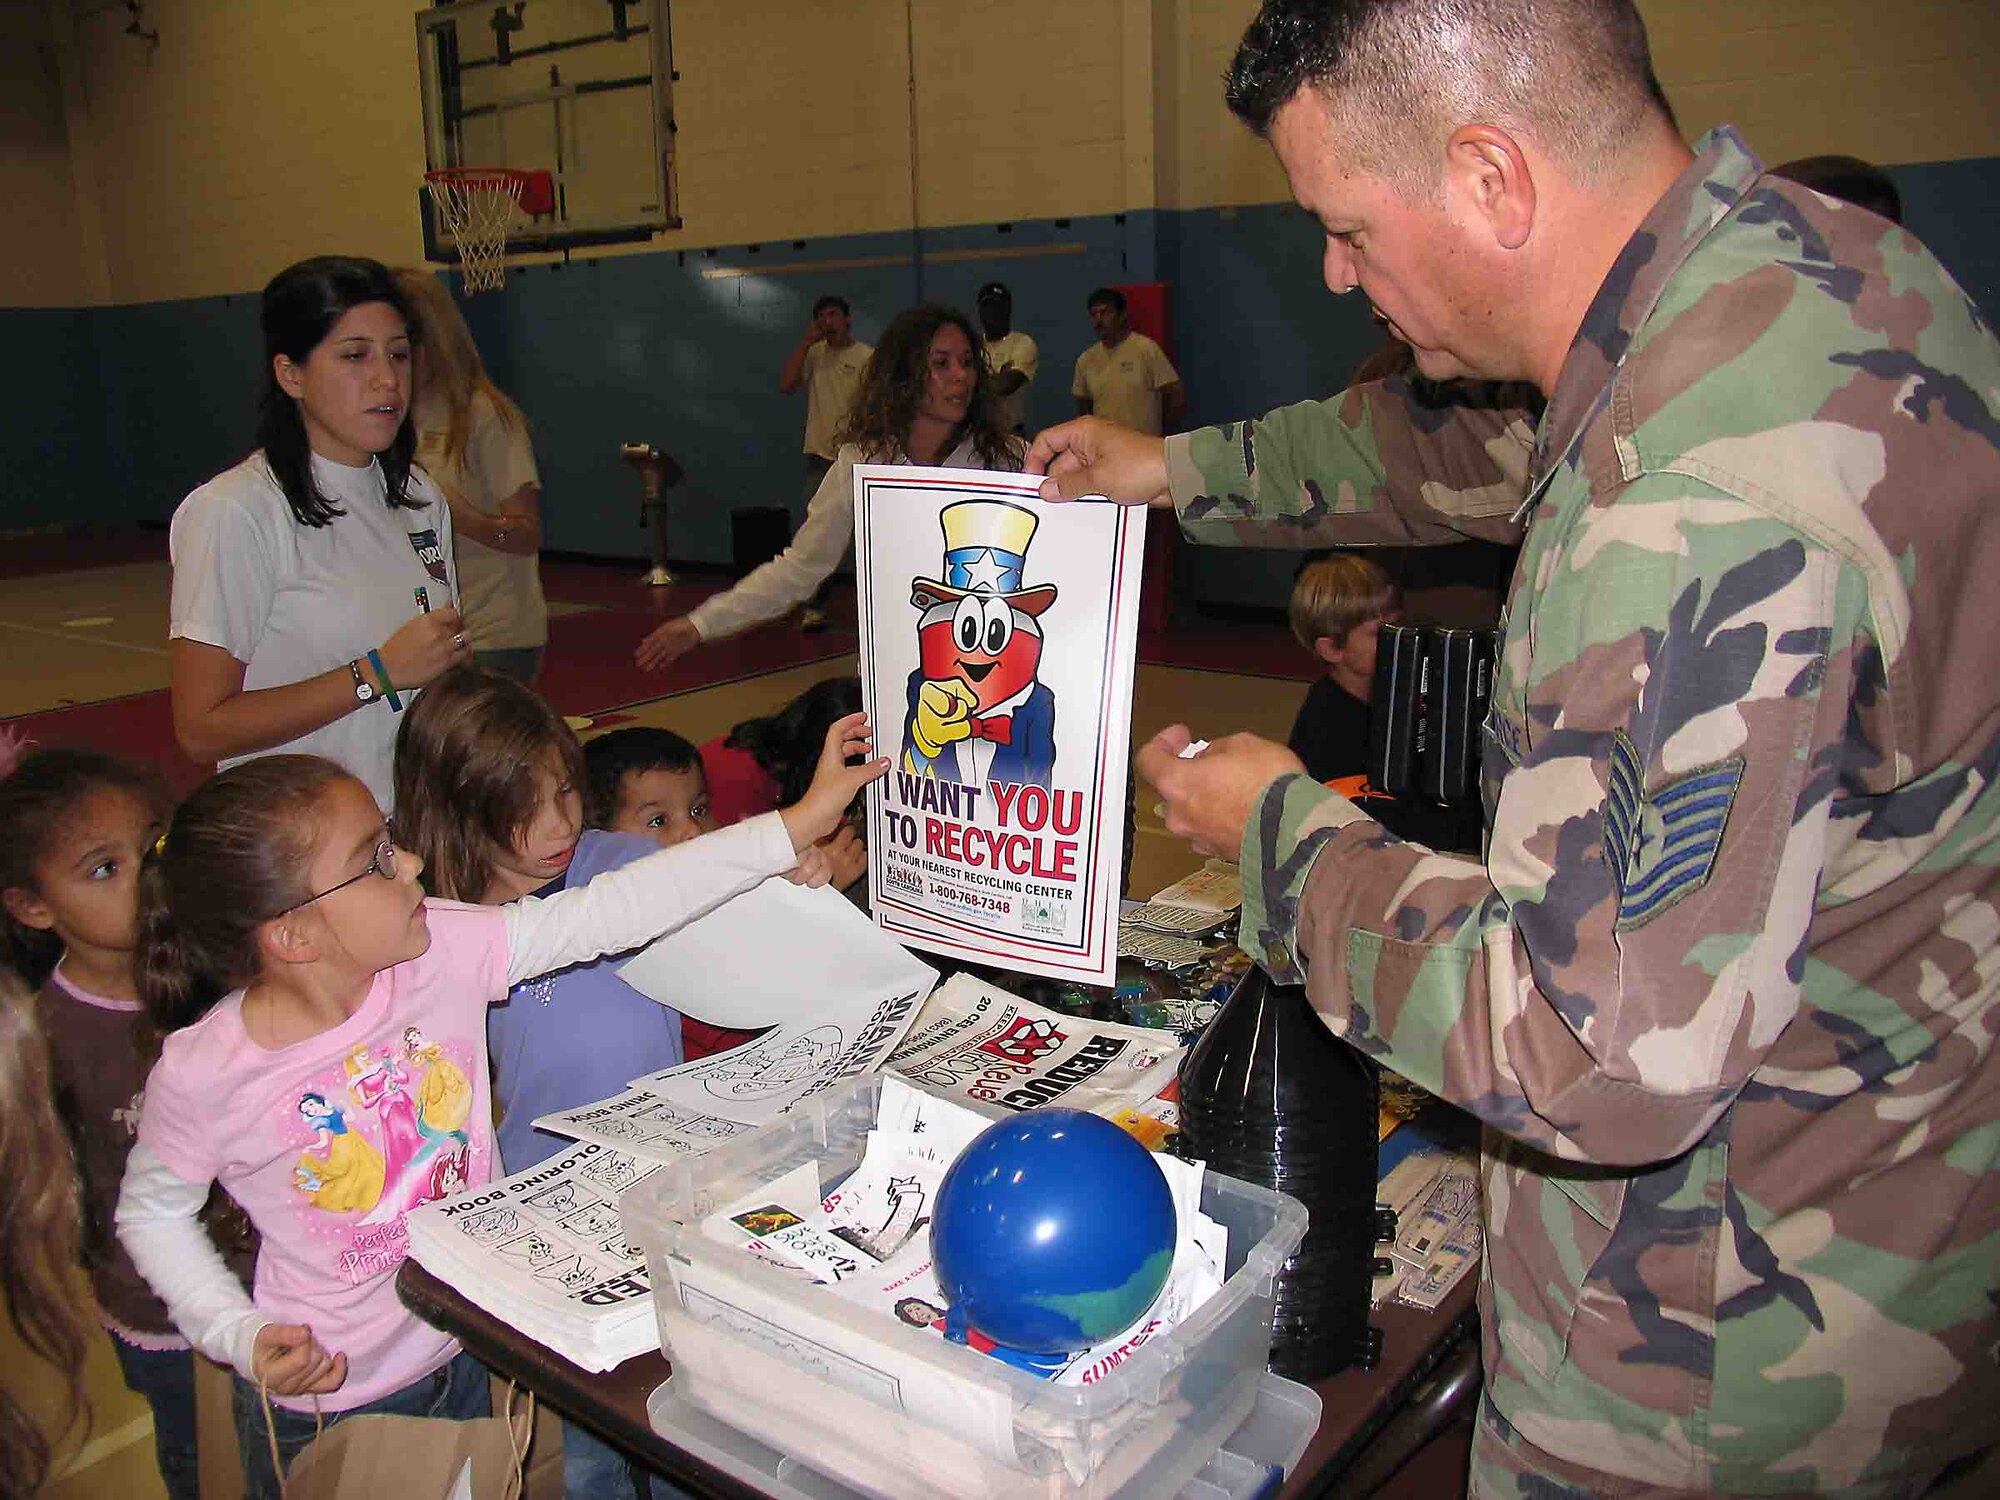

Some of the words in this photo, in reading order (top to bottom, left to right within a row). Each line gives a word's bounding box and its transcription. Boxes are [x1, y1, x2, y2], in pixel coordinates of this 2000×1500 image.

[883, 770, 890, 800] I
[897, 771, 981, 821] WANT
[989, 782, 1083, 836] YOU
[885, 809, 917, 849] TO
[925, 817, 1078, 882] RECYCLE
[887, 849, 898, 861] AT
[899, 852, 921, 869] YOUR
[922, 860, 962, 880] NEAREST
[964, 872, 1022, 893] RECYCLING
[1025, 883, 1073, 900] CENTER
[929, 882, 1010, 914] 1-800-768-7348
[956, 1013, 981, 1029] CES
[976, 995, 991, 1012] 20
[996, 1005, 1015, 1030] KEEP
[999, 1034, 1132, 1111] REDUC
[563, 1107, 612, 1122] BOOK
[439, 1191, 508, 1217] BOOK
[353, 1213, 407, 1251] Perfec
[1082, 1320, 1162, 1386] SUMTER
